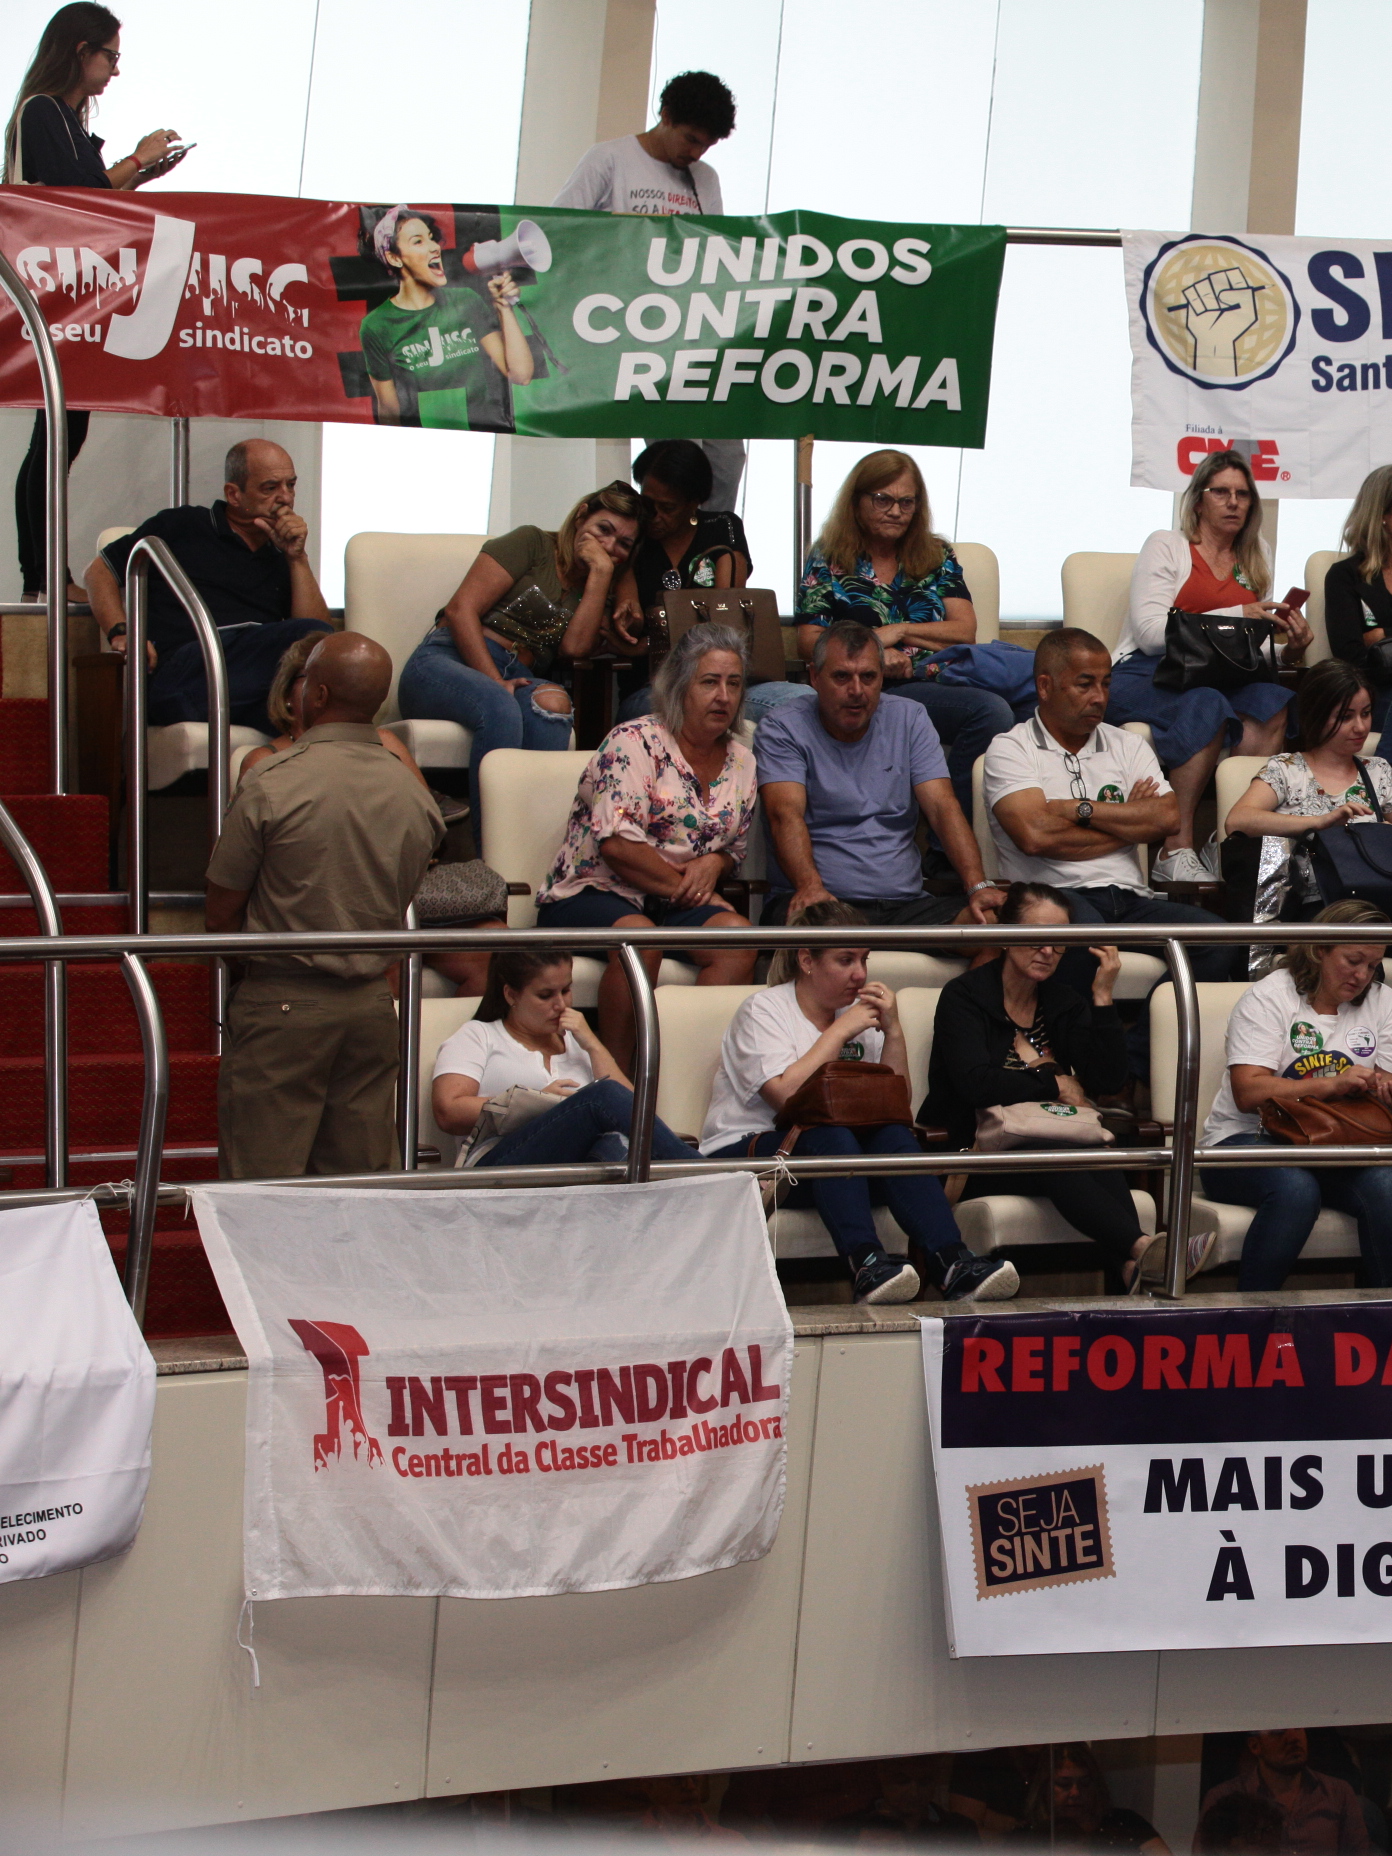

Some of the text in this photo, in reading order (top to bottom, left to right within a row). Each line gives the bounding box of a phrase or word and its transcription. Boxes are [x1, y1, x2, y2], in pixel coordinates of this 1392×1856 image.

[668, 192, 702, 209] DIREITO
[646, 234, 932, 287] UNIDOS
[50, 322, 101, 343] seu
[179, 322, 313, 359] sindicato
[572, 287, 883, 344] CONTRA
[445, 346, 480, 359] sindicato
[614, 348, 962, 412] REFORMA
[1185, 423, 1223, 435] Filiada à
[386, 1343, 781, 1437] INTERSINDICAL
[960, 1333, 1305, 1393] REFORMA
[391, 1412, 783, 1478] Central da Classe Trabalhadora
[1143, 1454, 1325, 1514] MAIS
[997, 1488, 1081, 1537] SEJA
[989, 1523, 1098, 1579] SINTE
[1206, 1529, 1256, 1602] À
